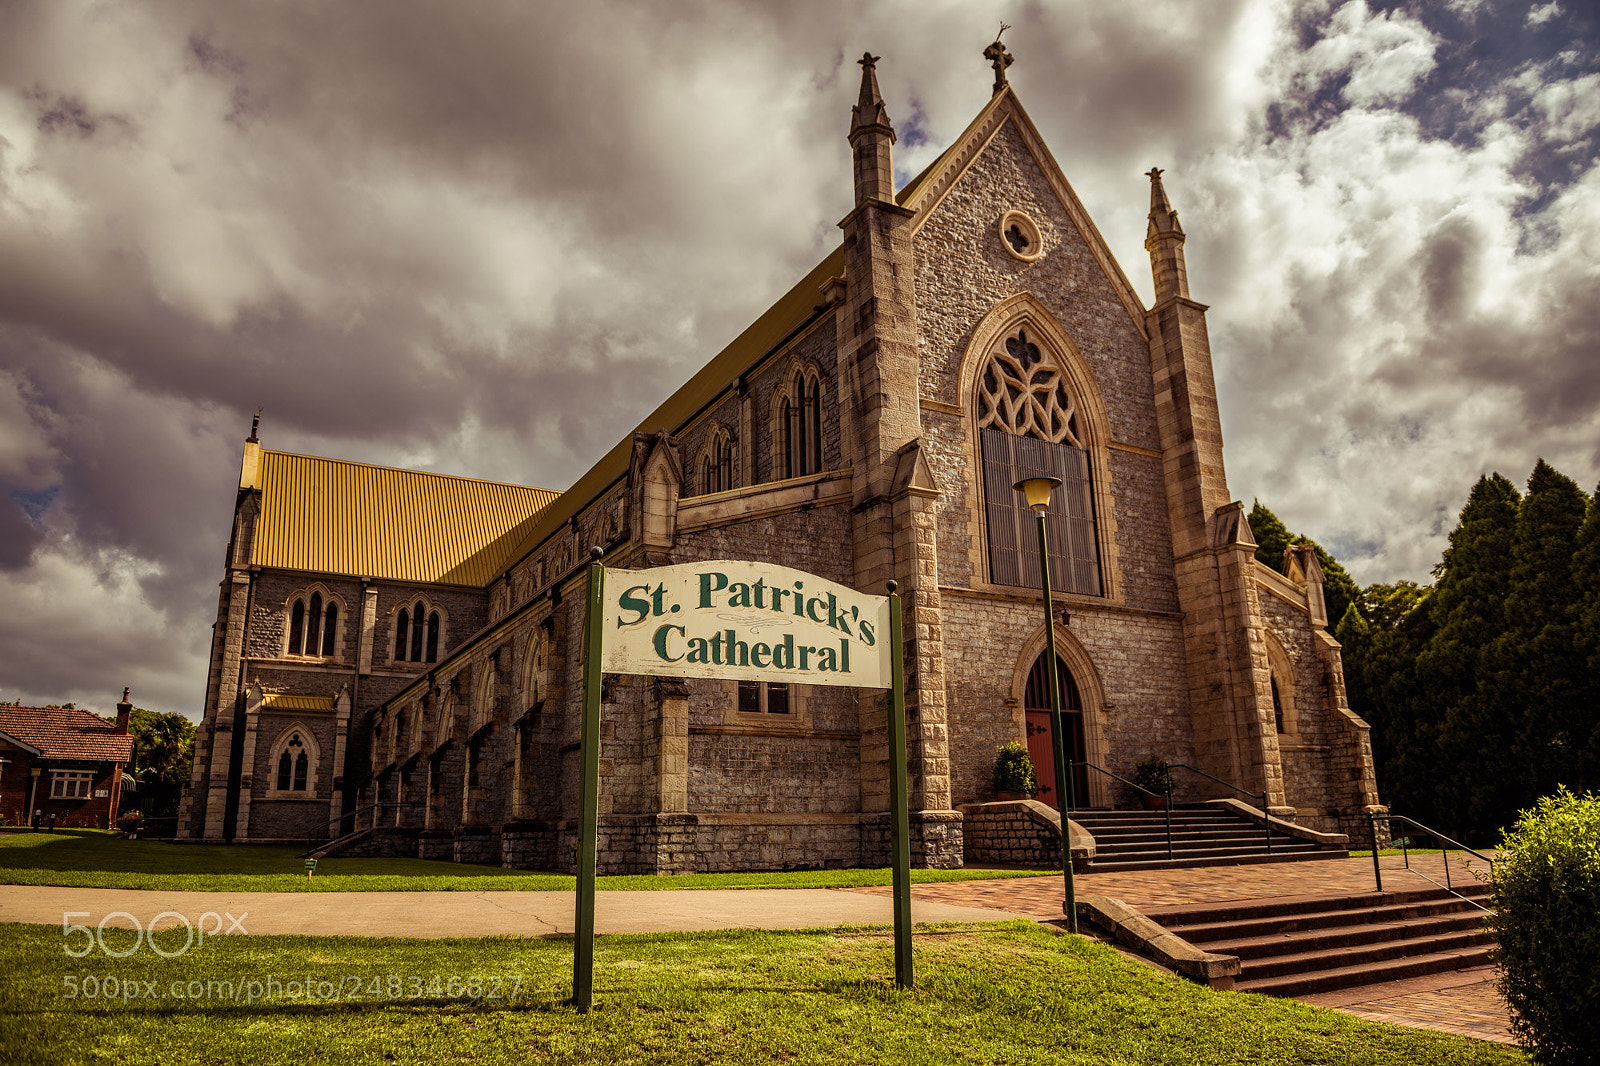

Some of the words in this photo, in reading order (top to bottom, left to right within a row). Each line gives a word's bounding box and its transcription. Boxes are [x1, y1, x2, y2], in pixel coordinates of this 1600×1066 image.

[617, 582, 681, 629] St.
[695, 572, 876, 646] Patrick's
[652, 624, 852, 673] Cathedral
